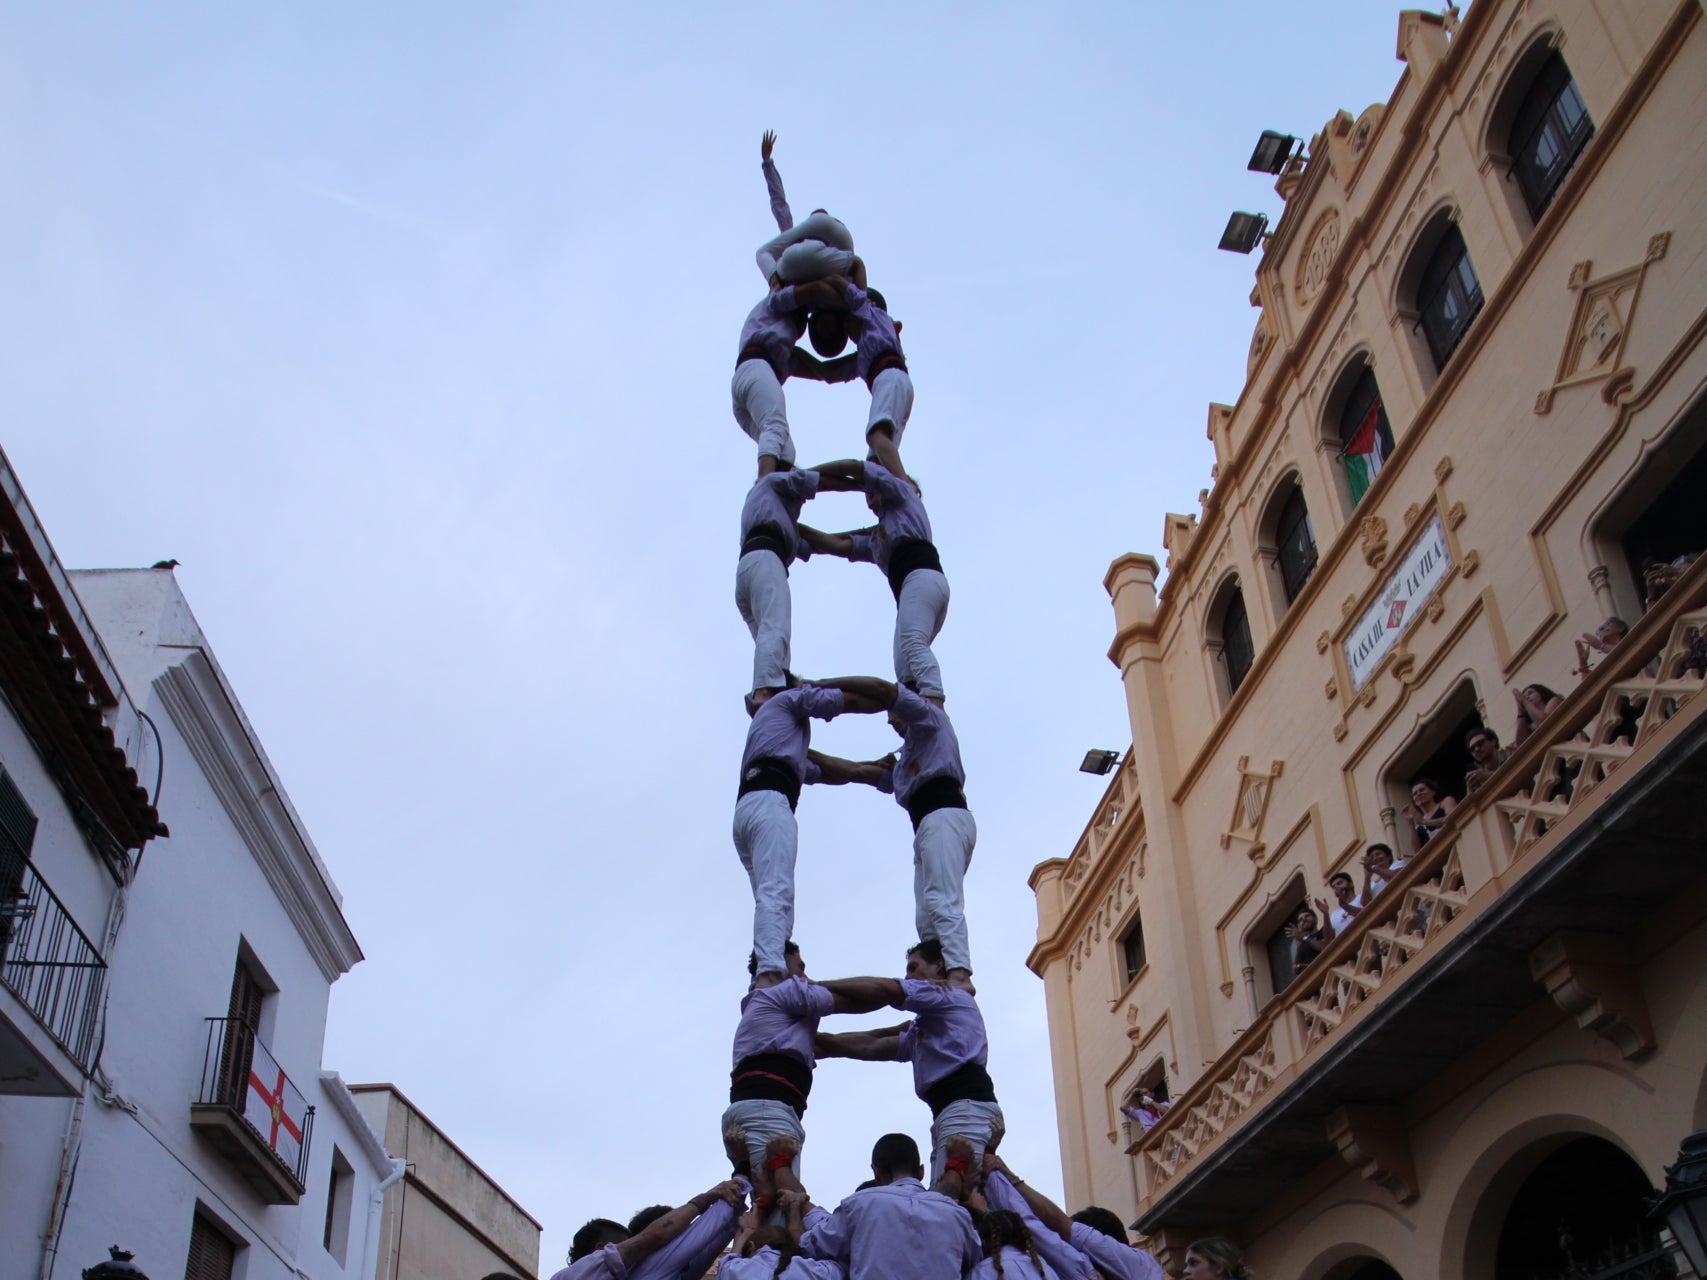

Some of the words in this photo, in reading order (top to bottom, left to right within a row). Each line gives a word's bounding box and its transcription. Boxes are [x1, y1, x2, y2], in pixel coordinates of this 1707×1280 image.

[1353, 633, 1378, 668] CASA
[1372, 618, 1384, 645] DE
[1406, 572, 1420, 597] LA
[1419, 541, 1442, 579] VILA
